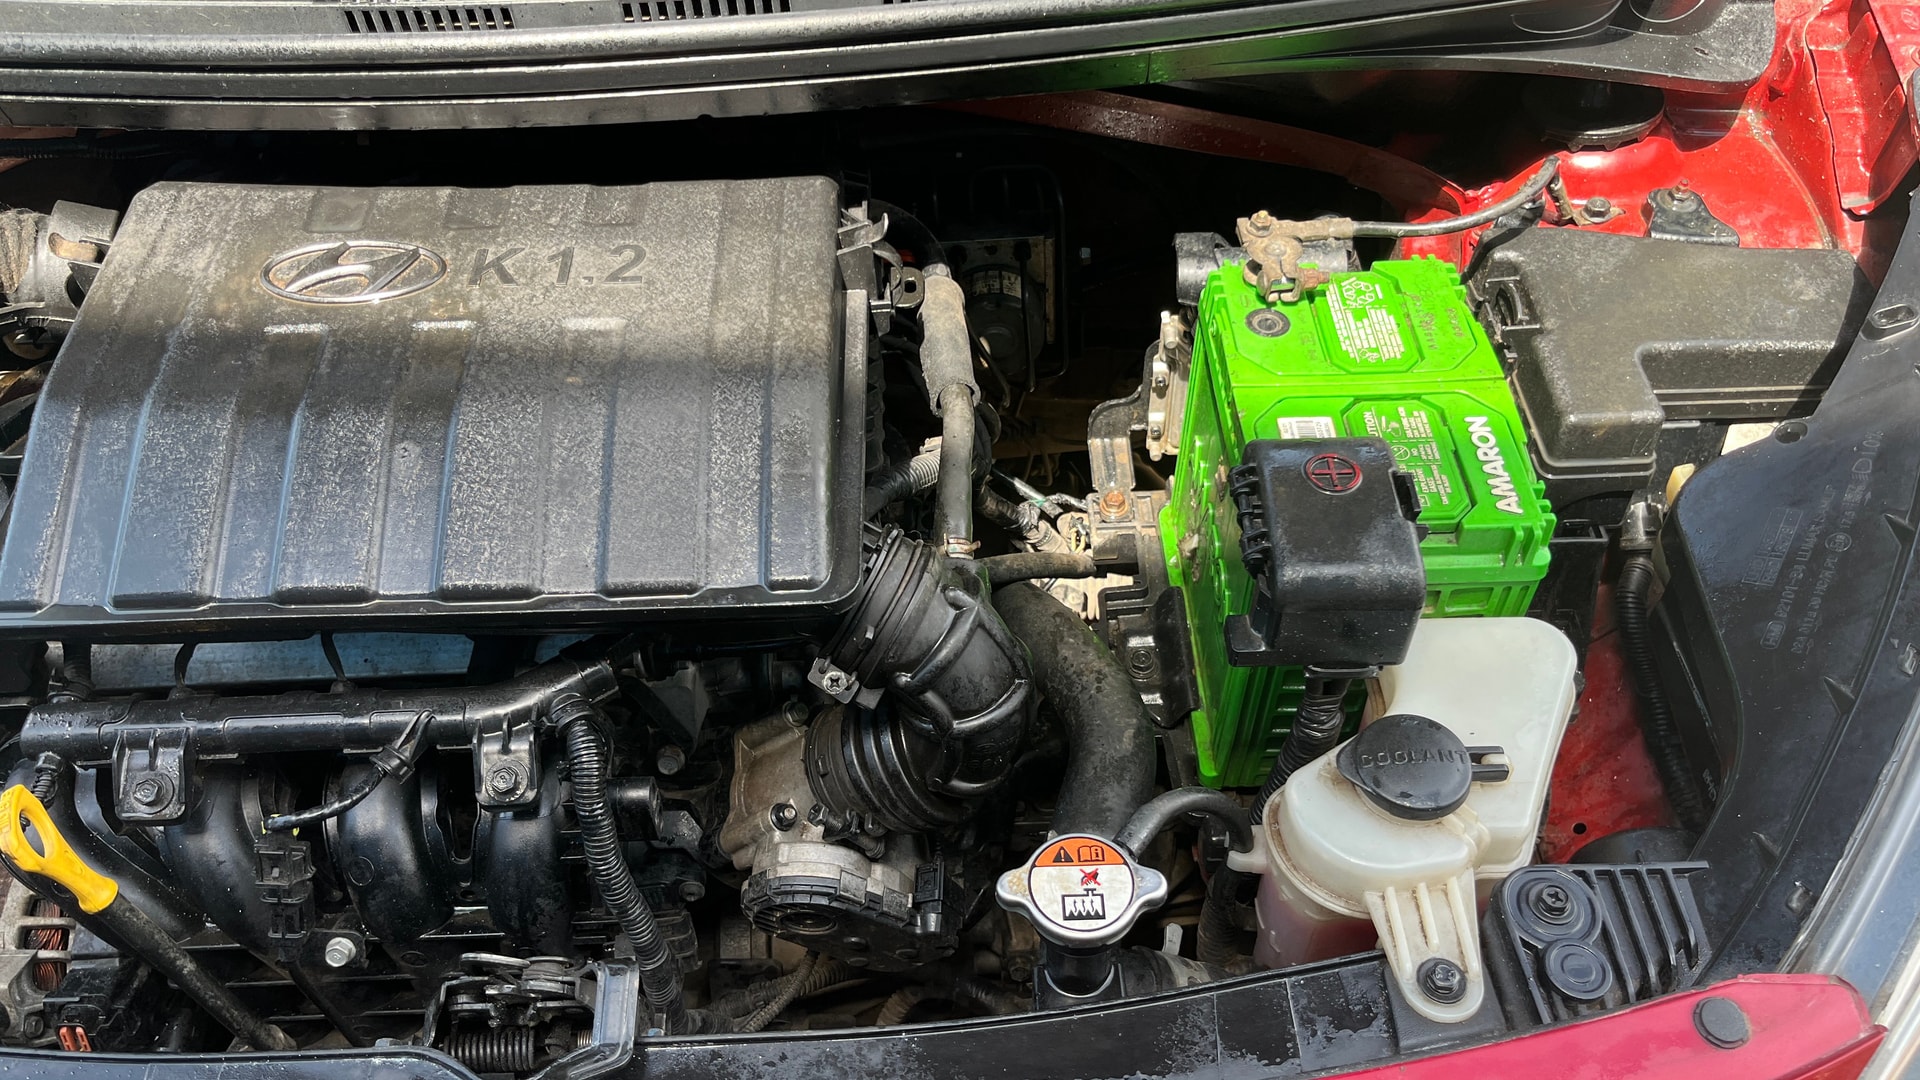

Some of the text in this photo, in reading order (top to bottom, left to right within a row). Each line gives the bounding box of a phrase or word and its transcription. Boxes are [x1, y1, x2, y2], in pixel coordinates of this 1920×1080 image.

[467, 244, 648, 288] K 1.2
[1464, 416, 1524, 514] AMARON
[1360, 748, 1469, 768] COOLANT
